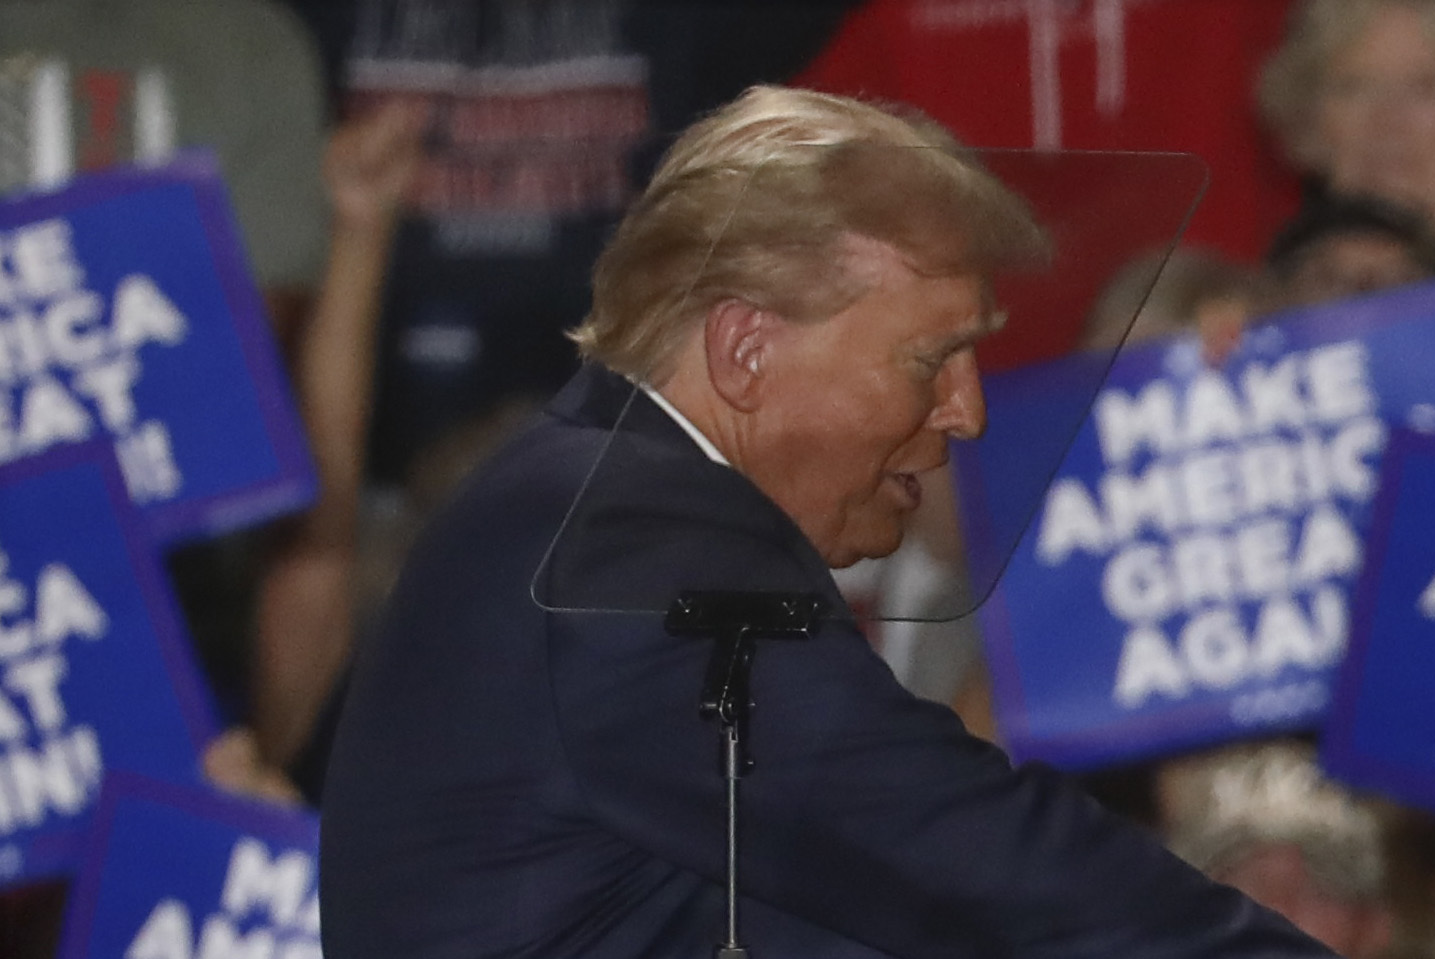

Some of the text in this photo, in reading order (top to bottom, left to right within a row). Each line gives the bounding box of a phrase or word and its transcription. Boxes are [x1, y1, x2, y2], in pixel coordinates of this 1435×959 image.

[1095, 341, 1376, 463] MAKE
[1036, 417, 1388, 564] AMERIC
[1103, 503, 1362, 624] GREA
